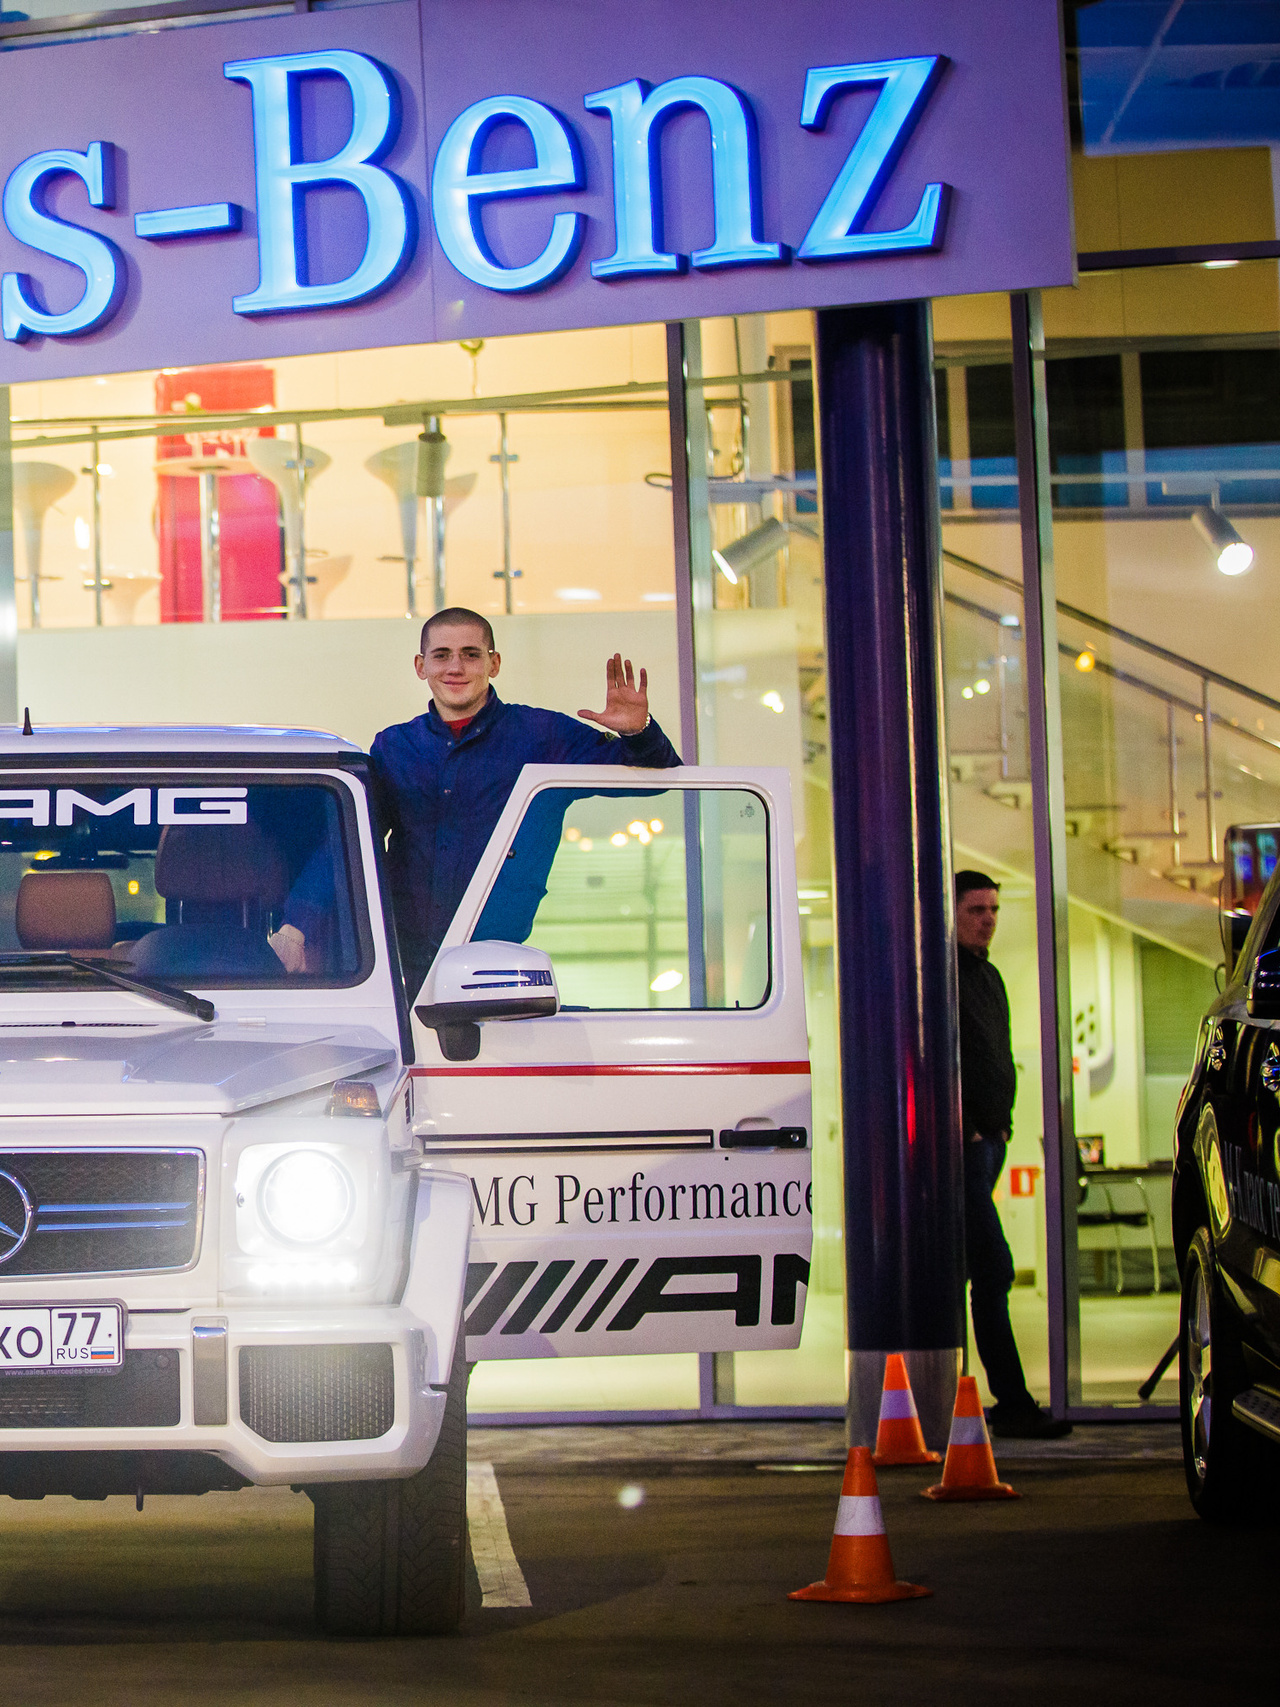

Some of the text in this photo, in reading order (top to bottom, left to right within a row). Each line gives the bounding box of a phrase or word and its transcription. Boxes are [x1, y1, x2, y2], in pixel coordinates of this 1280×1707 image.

[606, 1253, 811, 1331] A
[57, 1311, 102, 1346] 77
[56, 1346, 89, 1360] RUS
